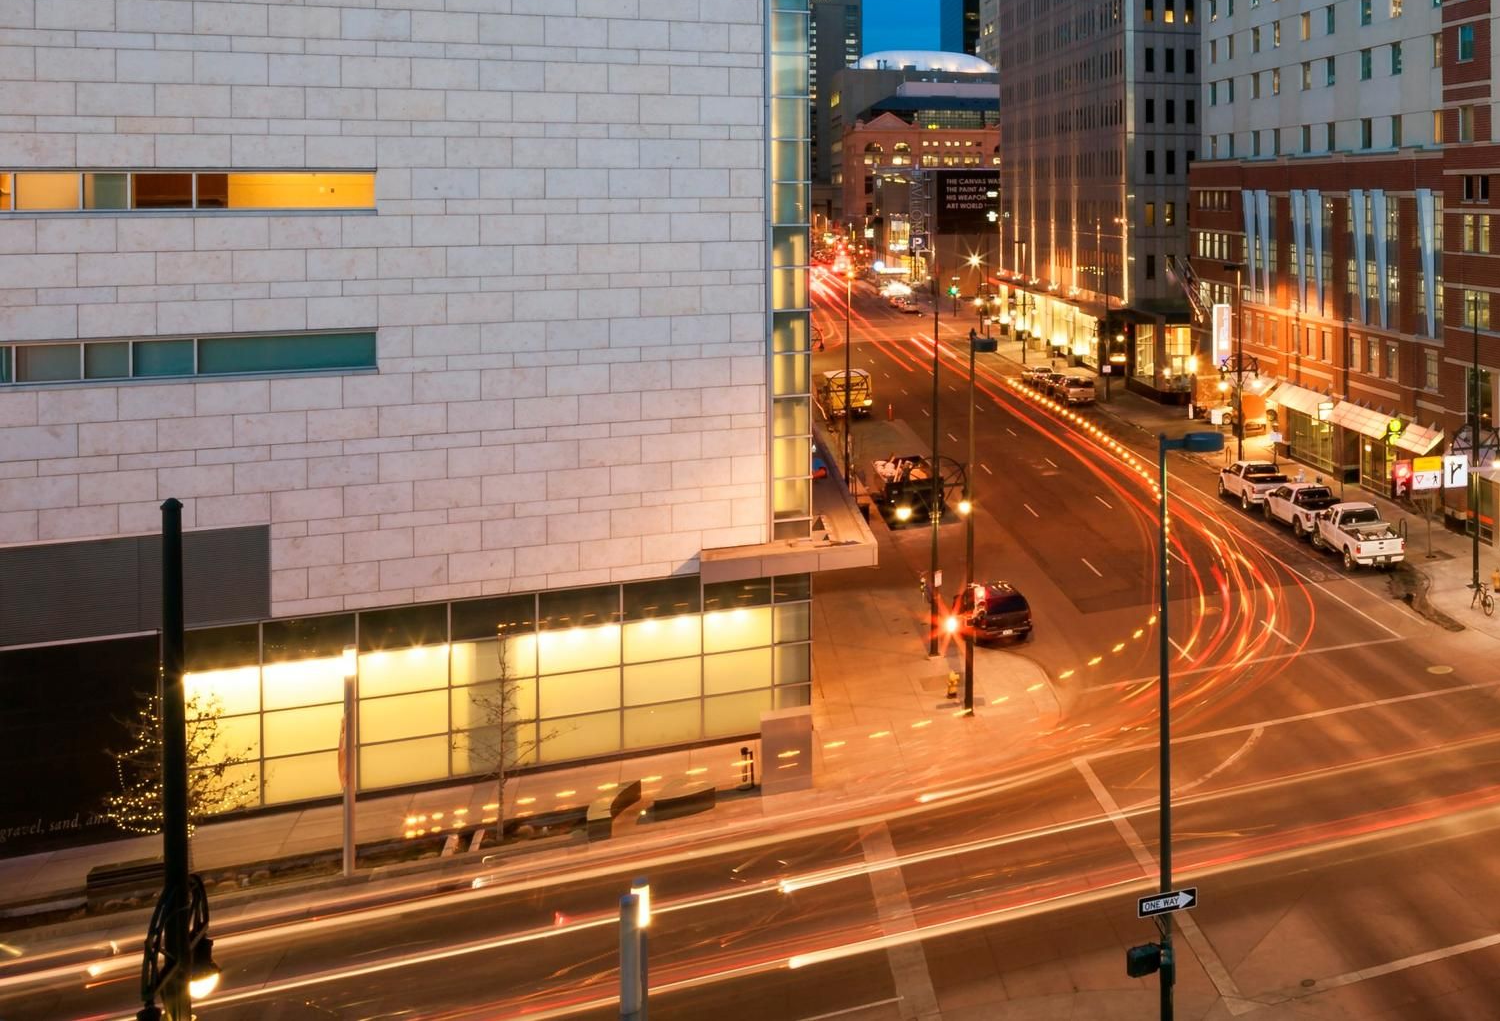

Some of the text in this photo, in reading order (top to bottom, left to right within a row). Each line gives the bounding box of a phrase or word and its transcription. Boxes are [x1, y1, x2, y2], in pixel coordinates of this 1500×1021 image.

[946, 202, 984, 210] ART WORLD
[1144, 896, 1180, 911] ONE WAY
